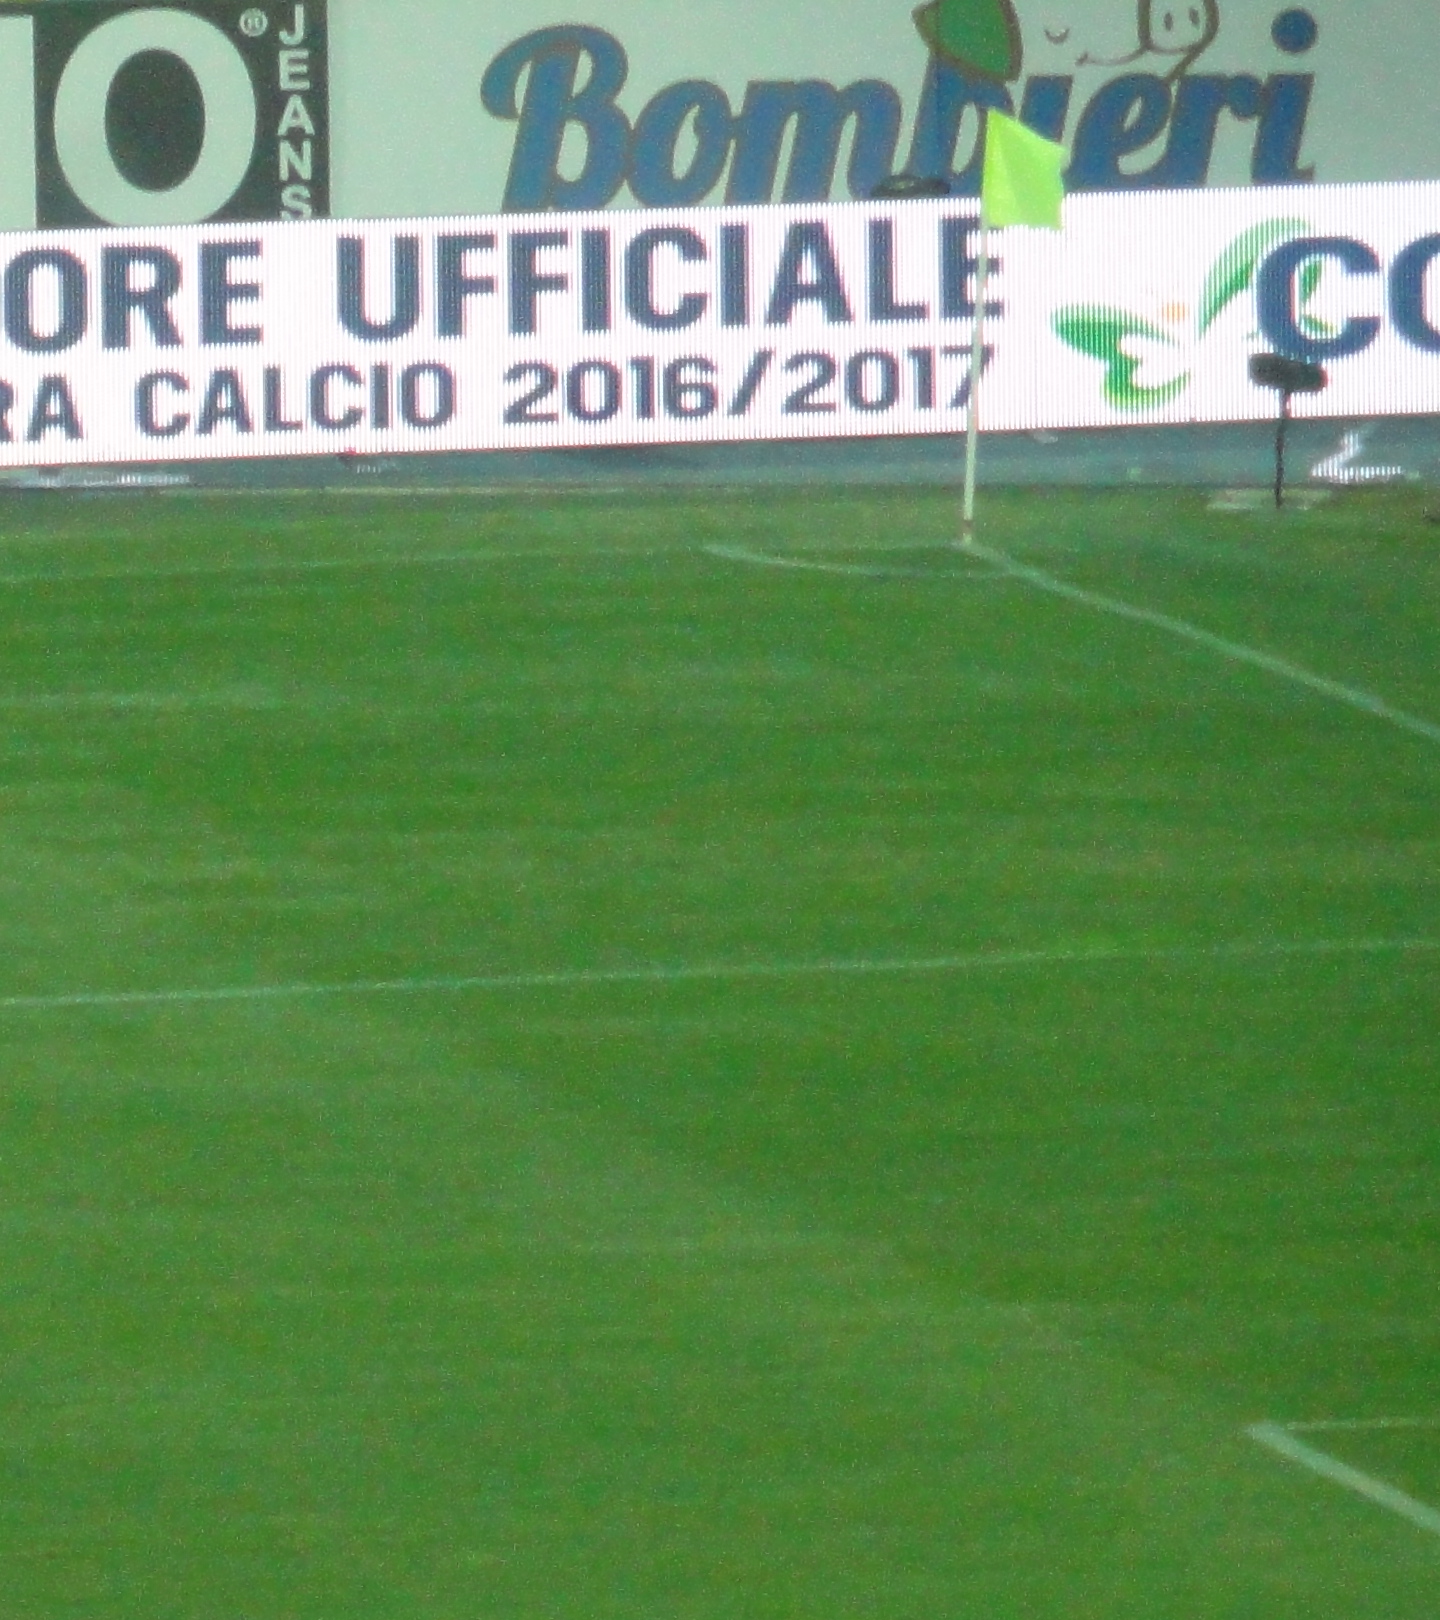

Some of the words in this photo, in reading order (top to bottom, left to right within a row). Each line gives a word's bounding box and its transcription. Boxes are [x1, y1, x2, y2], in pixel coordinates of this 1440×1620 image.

[277, 3, 316, 220] JEANS
[336, 214, 1006, 343] UFFICIALE
[133, 358, 457, 439] CALCIO
[502, 342, 996, 425] 2016/2017
